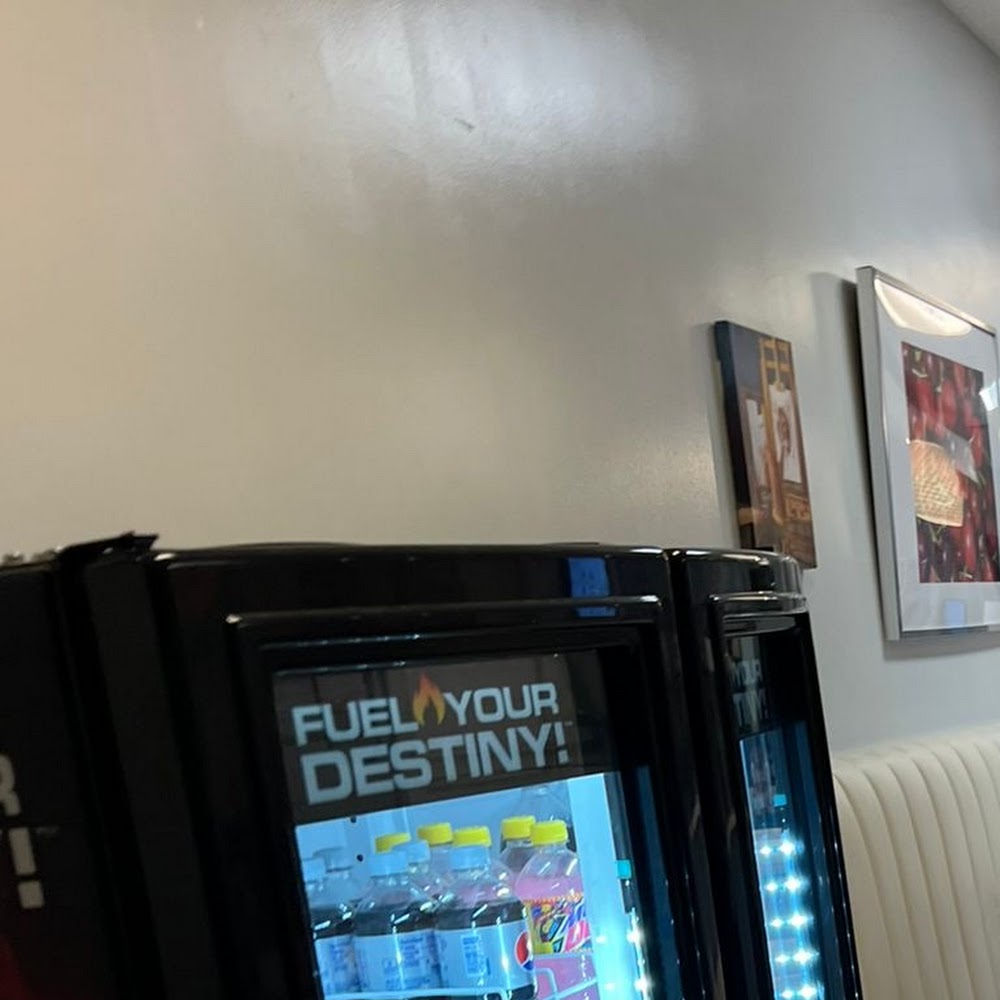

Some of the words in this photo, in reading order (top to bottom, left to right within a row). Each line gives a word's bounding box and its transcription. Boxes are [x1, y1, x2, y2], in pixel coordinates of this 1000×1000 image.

[291, 697, 419, 746] FUEL
[443, 683, 560, 725] YOUR
[301, 722, 570, 806] DESTINY!
